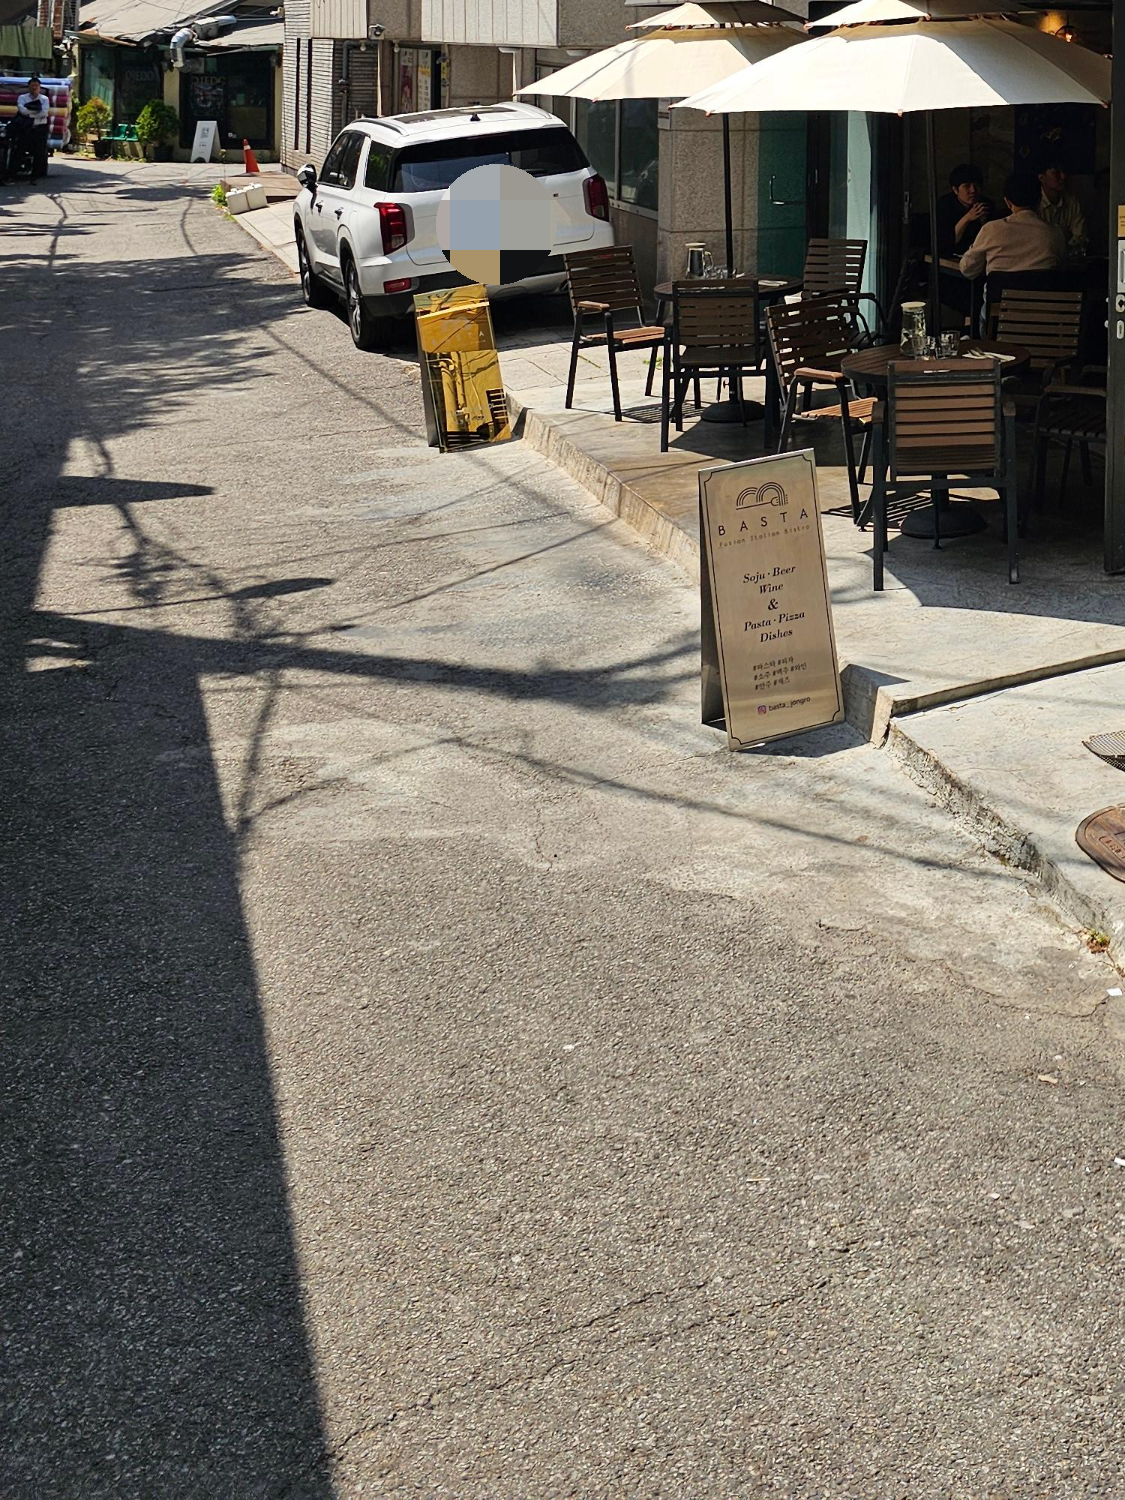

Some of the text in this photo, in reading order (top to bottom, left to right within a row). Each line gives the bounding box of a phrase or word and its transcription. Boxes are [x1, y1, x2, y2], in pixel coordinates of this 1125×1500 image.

[718, 508, 809, 536] BASTA
[719, 524, 810, 547] Fusion Italian Bistro
[743, 566, 796, 584] Soju Beer
[759, 583, 784, 594] Wine
[767, 598, 779, 611] &
[744, 612, 805, 632] Pasta Pizza
[760, 629, 793, 643] Dishes
